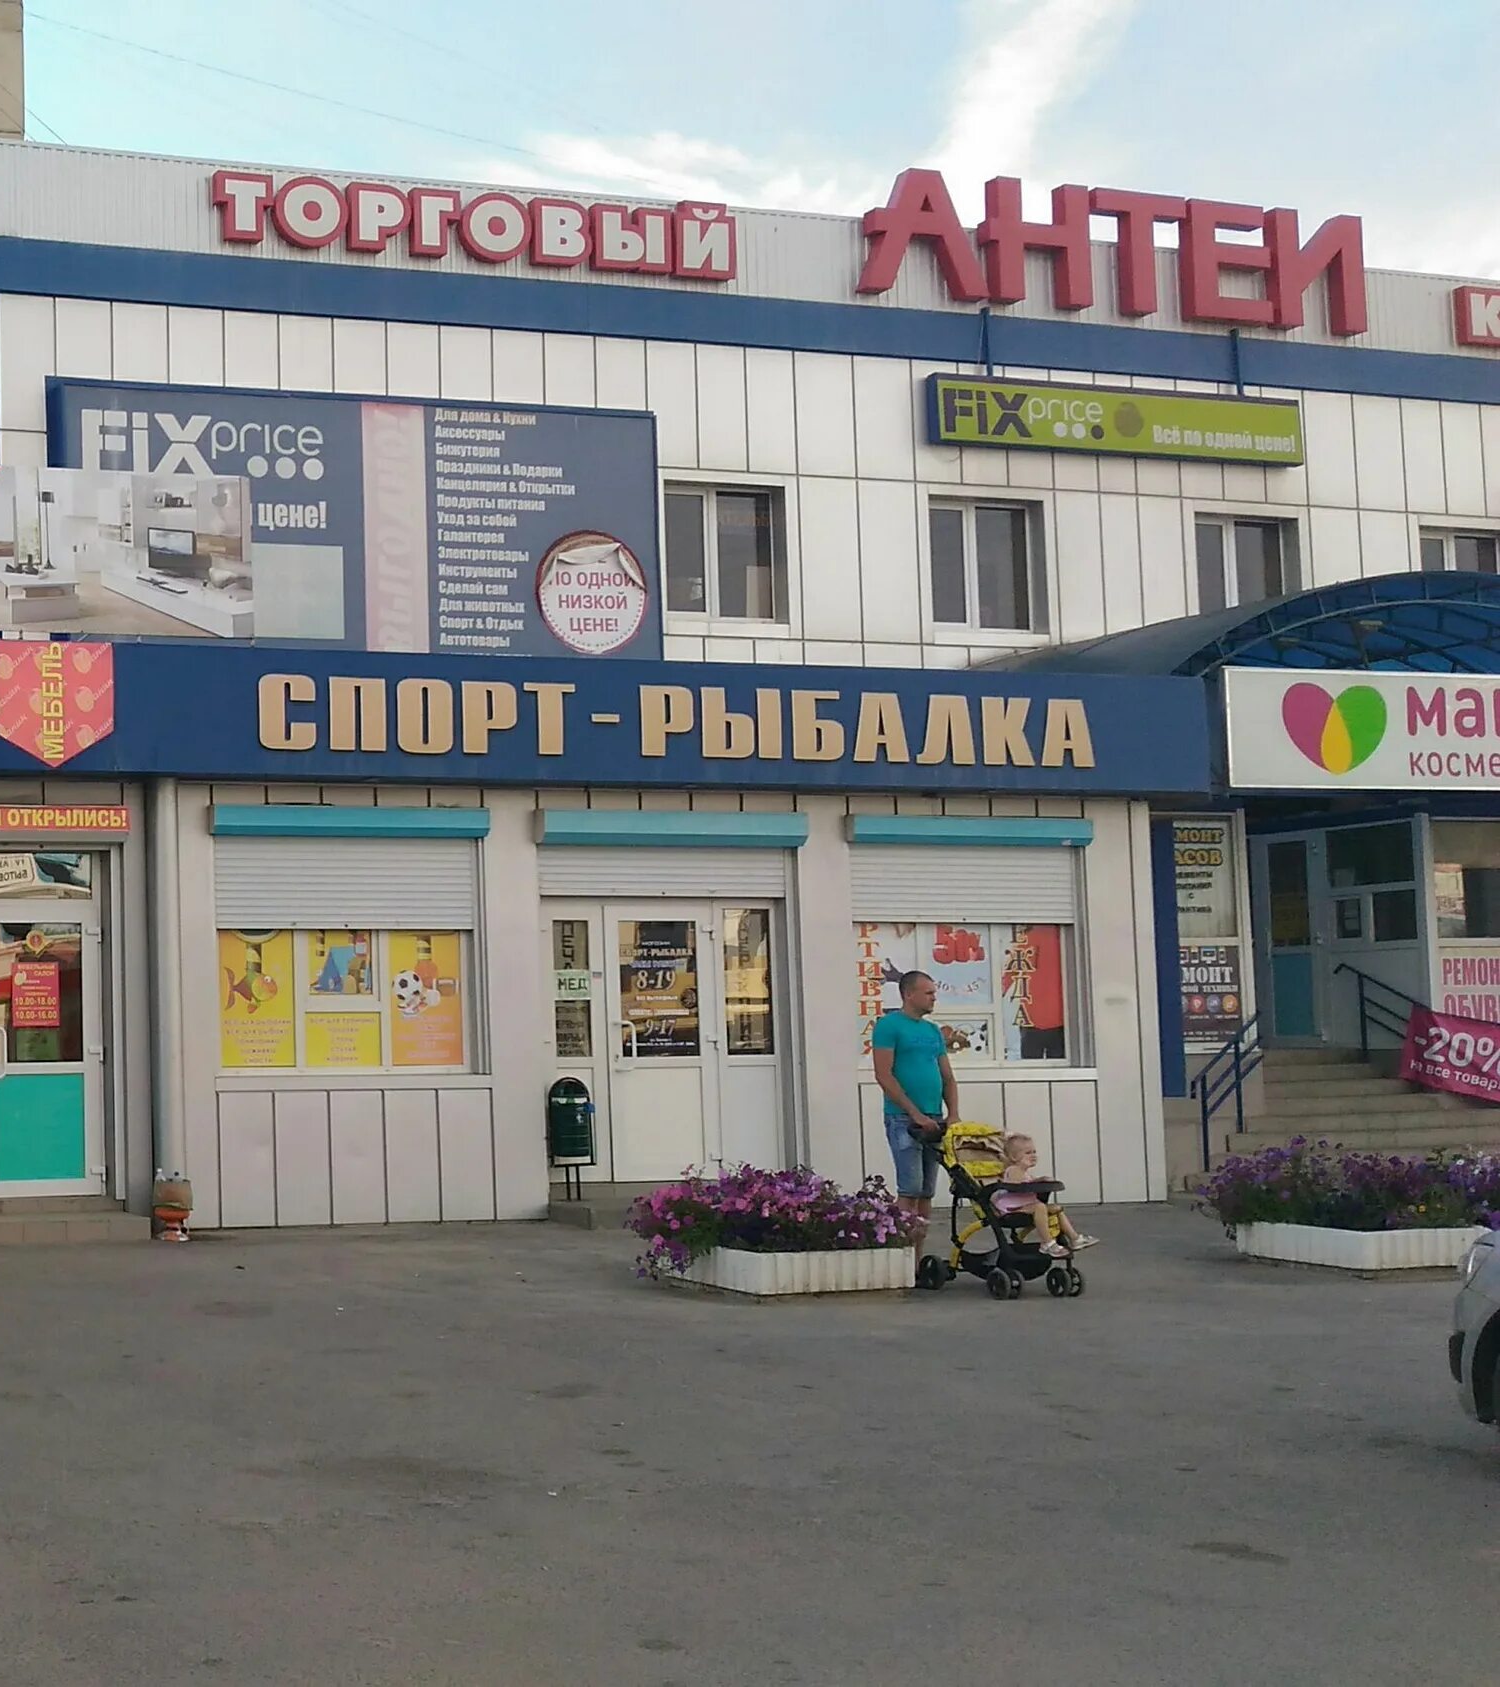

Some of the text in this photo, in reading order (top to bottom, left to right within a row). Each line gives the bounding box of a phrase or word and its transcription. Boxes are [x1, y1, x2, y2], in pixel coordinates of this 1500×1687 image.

[212, 170, 737, 281] ТОРГОВЫЙ
[435, 408, 536, 426] Для дома & Кухни
[1028, 396, 1103, 424] price
[211, 421, 324, 459] price
[435, 425, 505, 441] Аксессуары
[1153, 424, 1295, 453] Всё по одной цене!
[436, 442, 500, 458] Бижутерия
[436, 460, 563, 478] Праздники & Подарки
[436, 477, 575, 495] Канцелярия & Открытки
[437, 494, 545, 511] Продукты питания
[258, 501, 327, 531] цене!
[437, 511, 517, 526] Уход за собой
[437, 529, 505, 544] Галантерея
[438, 546, 529, 562] Электротовары
[438, 564, 517, 579] Инструменты
[439, 581, 508, 596] Сделай сам
[439, 598, 524, 614] Для животных
[558, 592, 628, 610] НИЗКОЙ
[440, 615, 524, 631] Спорт & Отдых
[569, 617, 619, 635] ЦЕНЕ!
[440, 633, 510, 648] Автотовары
[42, 642, 64, 759] МЕБЕЛЬ
[258, 673, 577, 757] СПОРТ
[640, 685, 1098, 770] РЫБАЛКА
[7, 809, 128, 828] ОТКРЫЛИСЬ!
[558, 977, 588, 991] МЕД
[636, 969, 676, 990] 8-19
[643, 1018, 676, 1037] 9-17
[1426, 1064, 1450, 1079] все
[1454, 1070, 1500, 1091] товар
